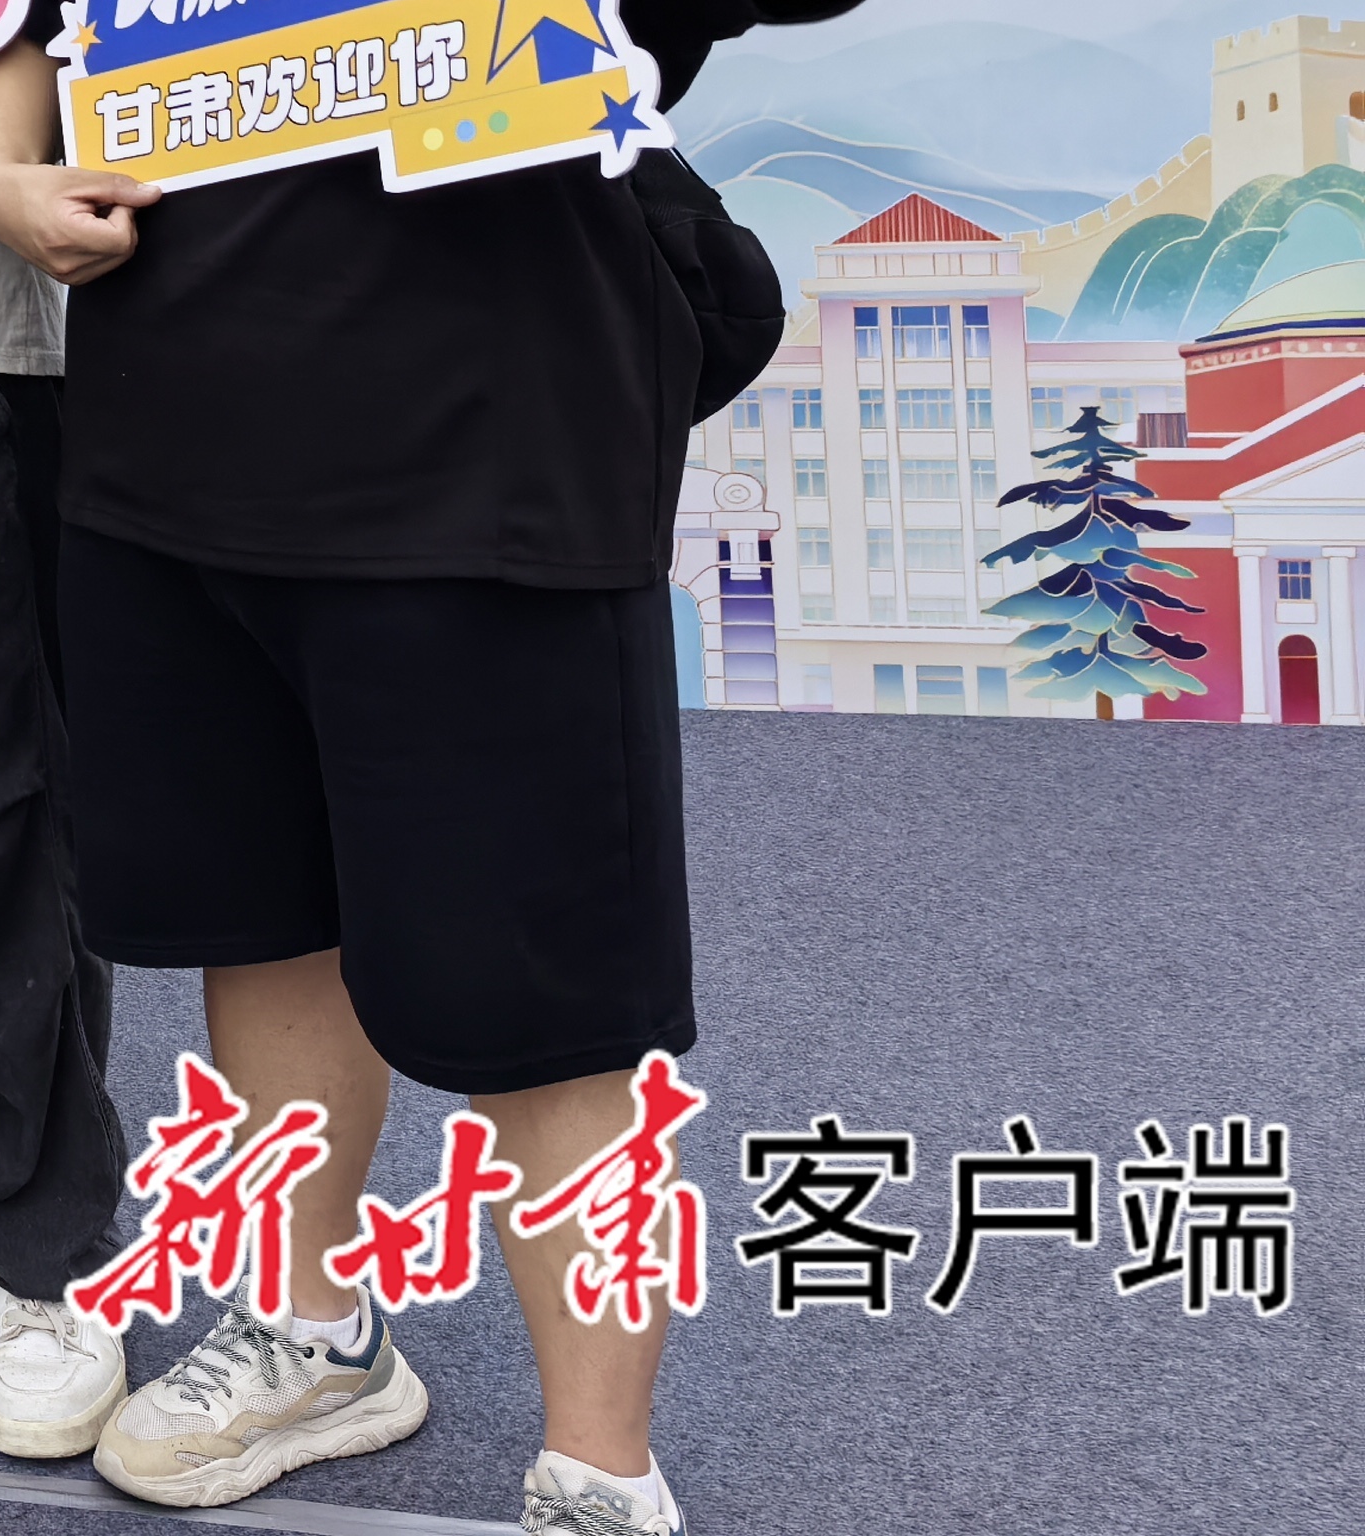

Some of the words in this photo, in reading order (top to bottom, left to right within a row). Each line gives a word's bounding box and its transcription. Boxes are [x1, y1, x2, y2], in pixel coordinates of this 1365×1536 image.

[94, 20, 468, 163] 甘肃欢迎你
